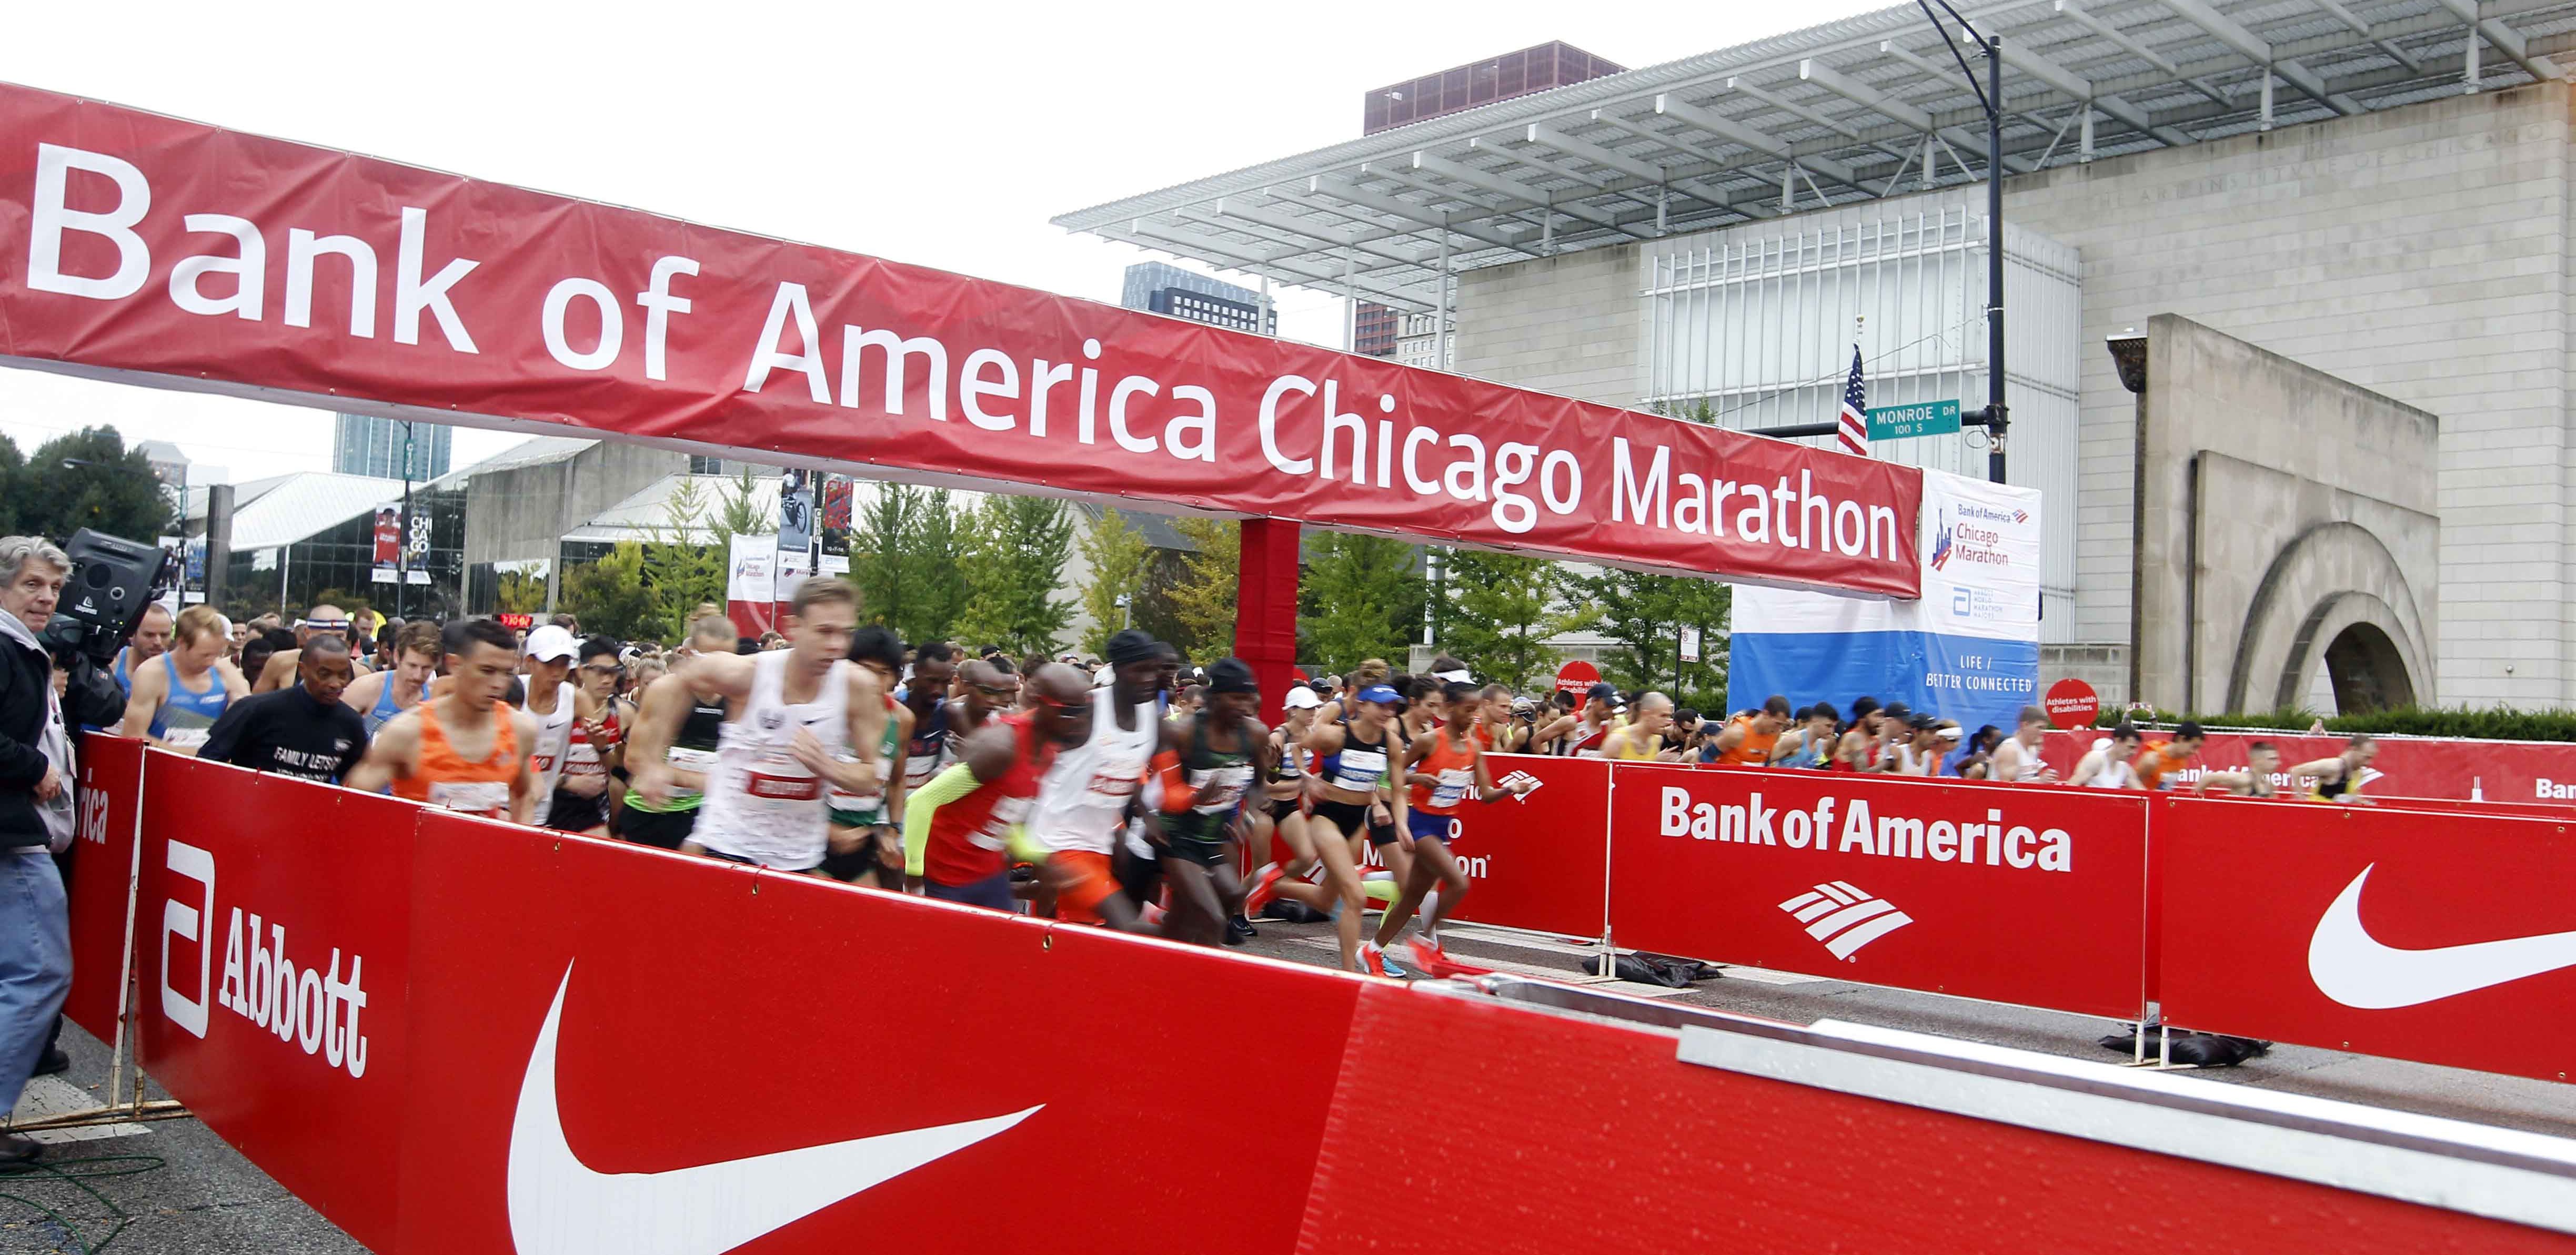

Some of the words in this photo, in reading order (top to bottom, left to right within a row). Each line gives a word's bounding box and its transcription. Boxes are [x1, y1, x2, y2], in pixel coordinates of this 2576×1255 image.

[27, 143, 480, 354] Bank
[542, 256, 700, 381] of
[743, 281, 1216, 463] America
[1259, 375, 1581, 533] Chicago
[1612, 437, 1896, 562] Marathon
[1876, 407, 1934, 425] MONROE
[1943, 406, 1956, 416] DR
[1895, 425, 1910, 434] 100
[1917, 423, 1923, 432] S
[1958, 504, 1975, 518] Bank
[1976, 508, 1983, 518] of
[1984, 508, 2011, 523] America
[410, 516, 433, 533] CHI
[408, 528, 428, 541] CA
[1957, 523, 1999, 548] Chicago
[409, 540, 429, 553] GO
[1956, 544, 2008, 565] Marathon
[1960, 655, 1981, 670] LIFE
[1926, 673, 1961, 689] BETTER
[1967, 676, 2031, 692] CONNECTED
[2052, 704, 2092, 714] disabilities
[274, 746, 309, 767] FAMILY
[2536, 778, 2576, 799] Ban
[77, 767, 108, 844] rica
[1661, 787, 1777, 846] Bank
[1783, 796, 1835, 849] of
[1839, 799, 2070, 872] America
[219, 907, 367, 1079] Abbott
